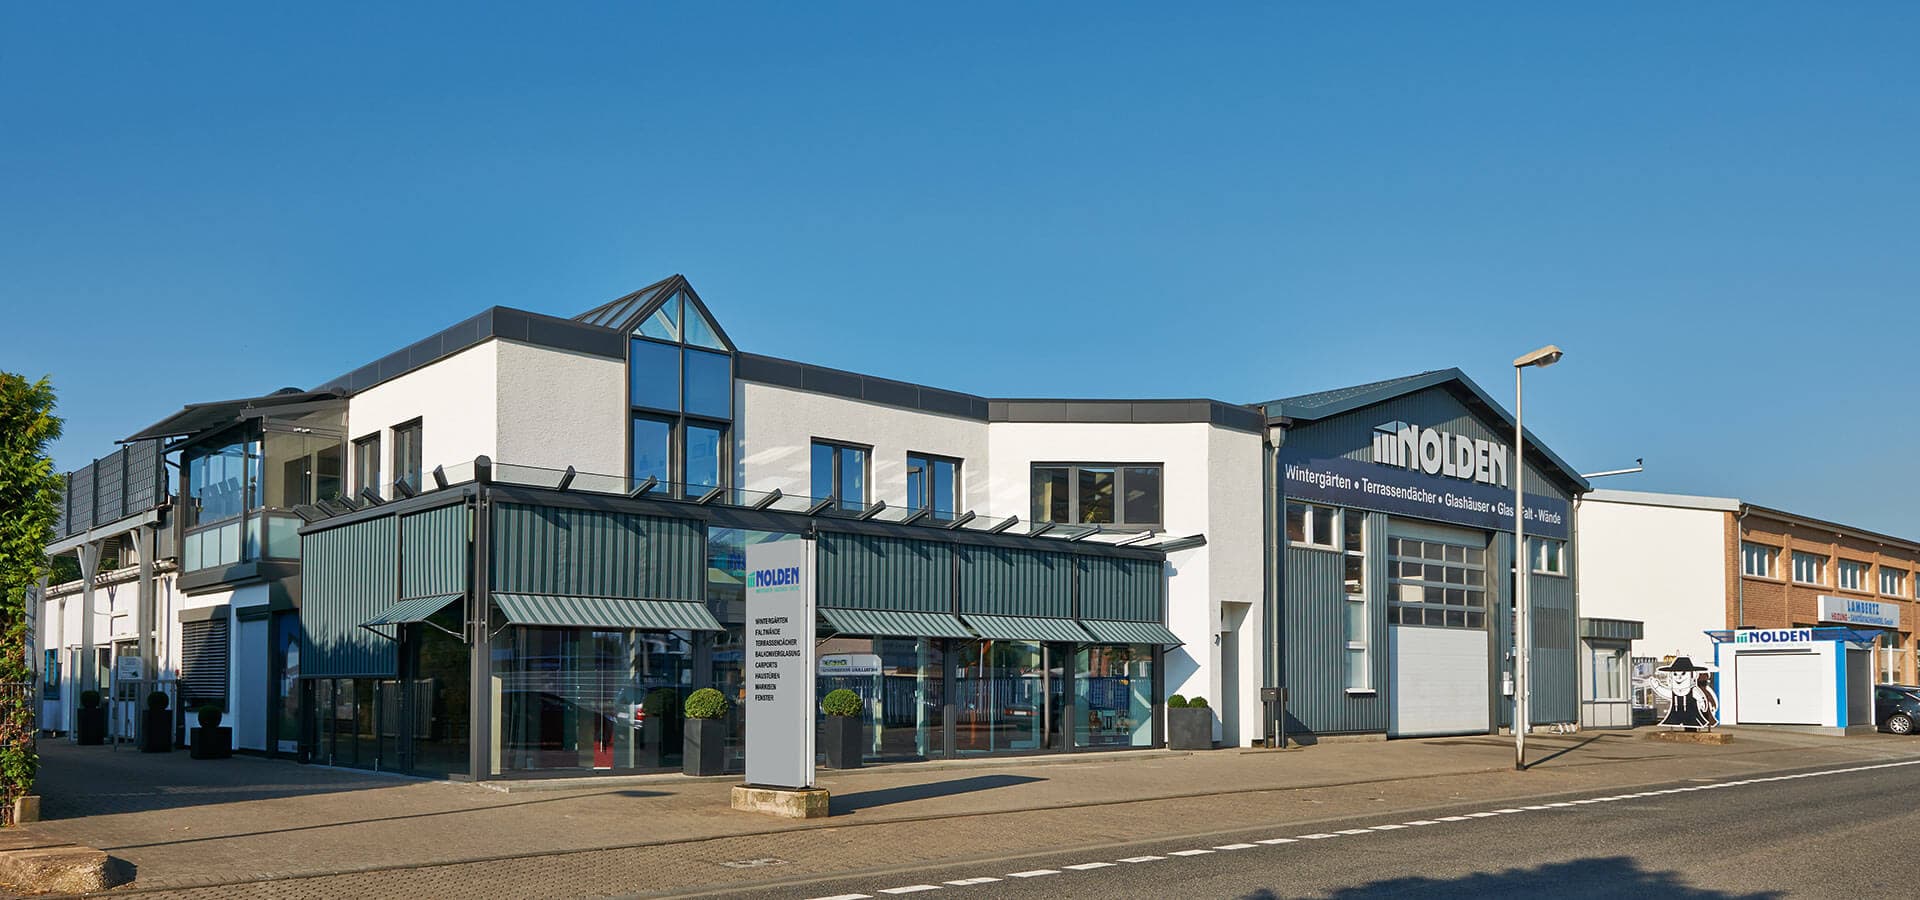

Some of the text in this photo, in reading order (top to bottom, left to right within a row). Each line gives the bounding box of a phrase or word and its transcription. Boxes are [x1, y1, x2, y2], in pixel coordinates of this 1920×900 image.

[1398, 423, 1507, 487] NOLDEN
[1285, 463, 1351, 489] Wintergärten
[1362, 477, 1437, 504] Terrassendächer
[1445, 493, 1490, 513] Glashäuser
[1497, 502, 1514, 517] Glas
[1538, 509, 1561, 525] Wände
[756, 566, 800, 587] NOLDEN
[1847, 600, 1880, 615] LAMBERTZ
[755, 616, 789, 625] WINTERGÄRTEN
[755, 638, 798, 646] TERRASSENDÄCHER
[1749, 630, 1810, 643] NOLDEN
[755, 649, 801, 658] BALKONVERGLASUNG
[755, 661, 778, 669] CARPORTS
[755, 694, 775, 702] FENSTER
